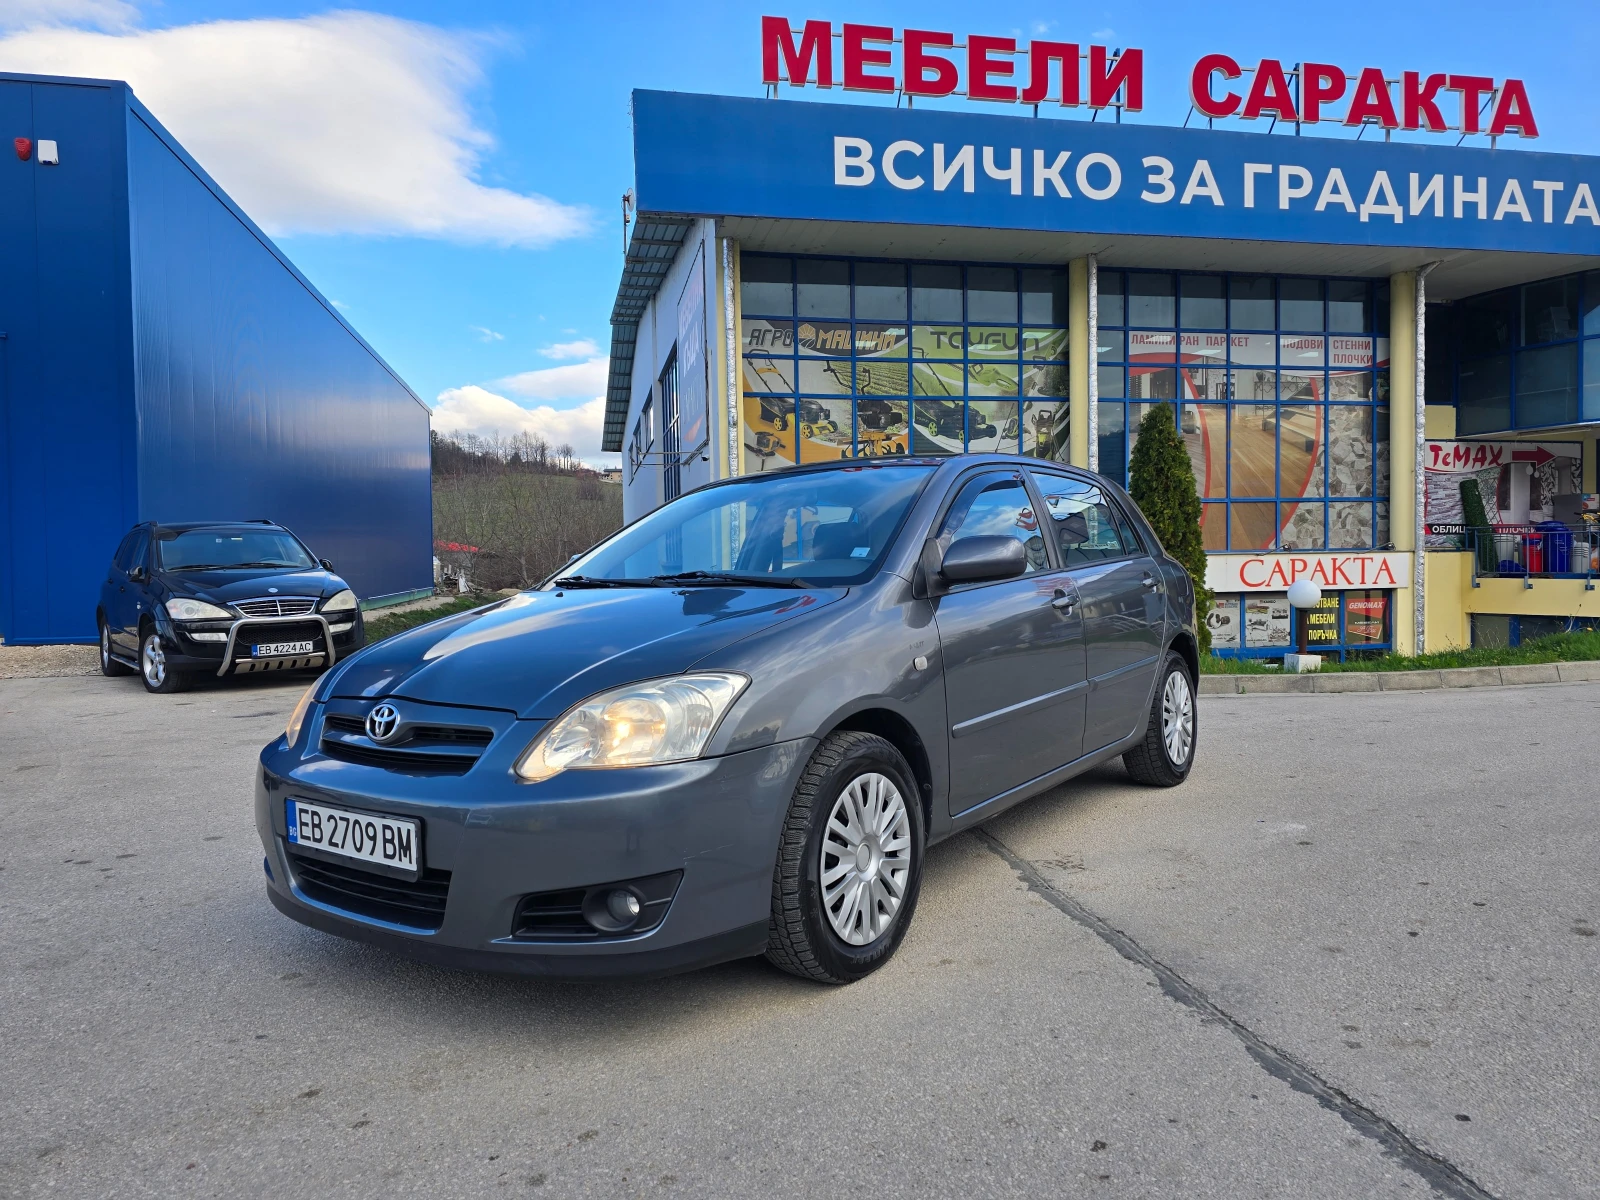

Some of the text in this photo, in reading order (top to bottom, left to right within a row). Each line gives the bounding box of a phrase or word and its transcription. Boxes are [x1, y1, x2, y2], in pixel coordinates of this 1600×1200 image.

[762, 15, 1539, 139] МЕБЕЛИ САРАКТА
[833, 136, 1600, 226] ВСИЧКО ЗА ГРАДИНАТА
[748, 328, 795, 348] АГРО
[1333, 340, 1371, 350] СТЕННИ
[1333, 353, 1373, 364] ПЛОЧКИ
[1239, 557, 1397, 588] САРАКТА
[1310, 613, 1335, 625] МЕБЕЛИ
[1308, 629, 1338, 641] ПОРЪЧКА
